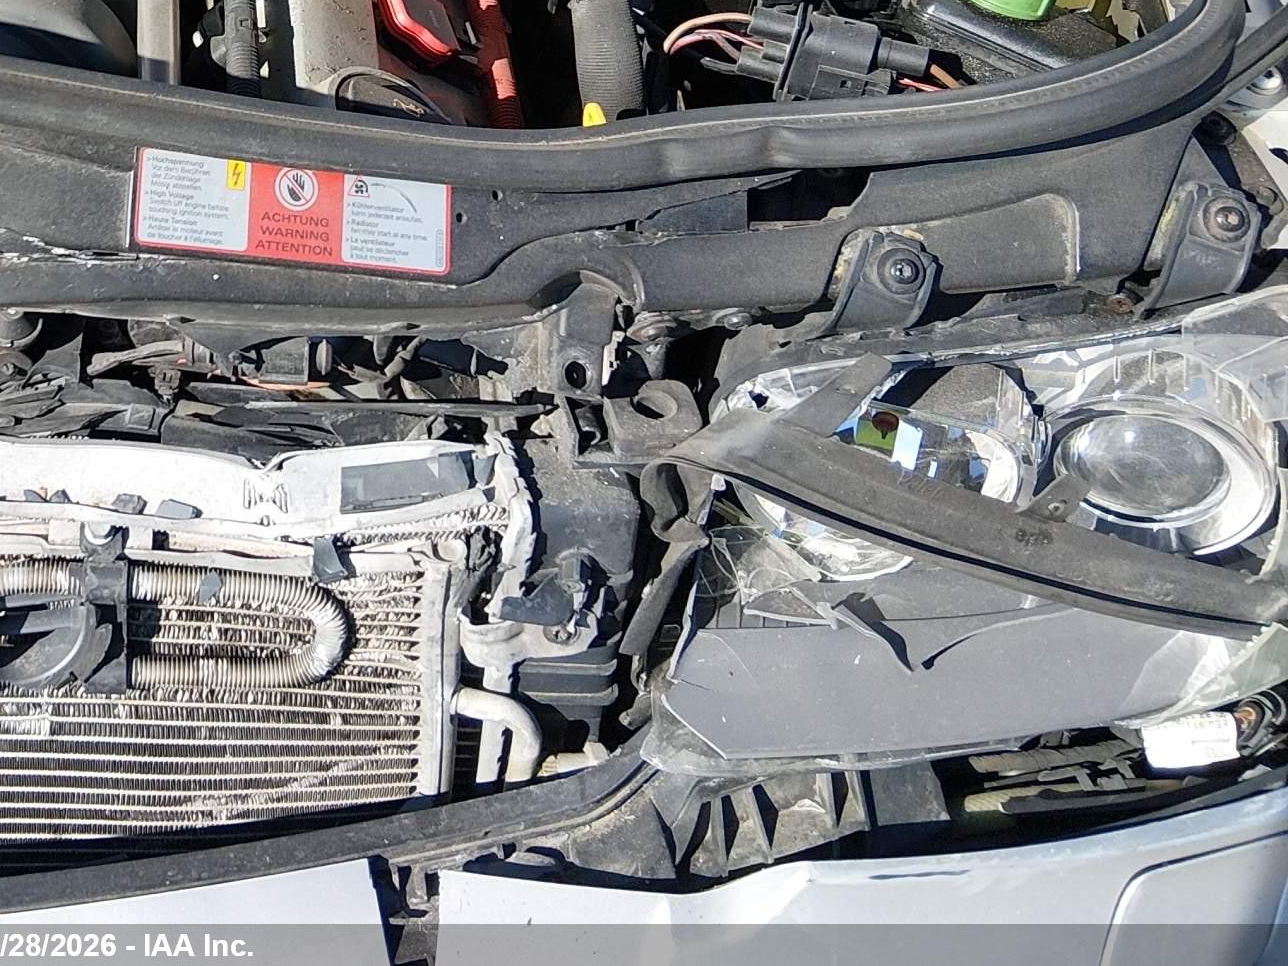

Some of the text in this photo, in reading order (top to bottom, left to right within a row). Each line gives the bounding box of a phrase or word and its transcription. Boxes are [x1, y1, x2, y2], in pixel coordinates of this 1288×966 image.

[261, 212, 329, 227] ACHTUNG
[260, 225, 330, 242] WARNING
[255, 240, 333, 257] ATTENTION
